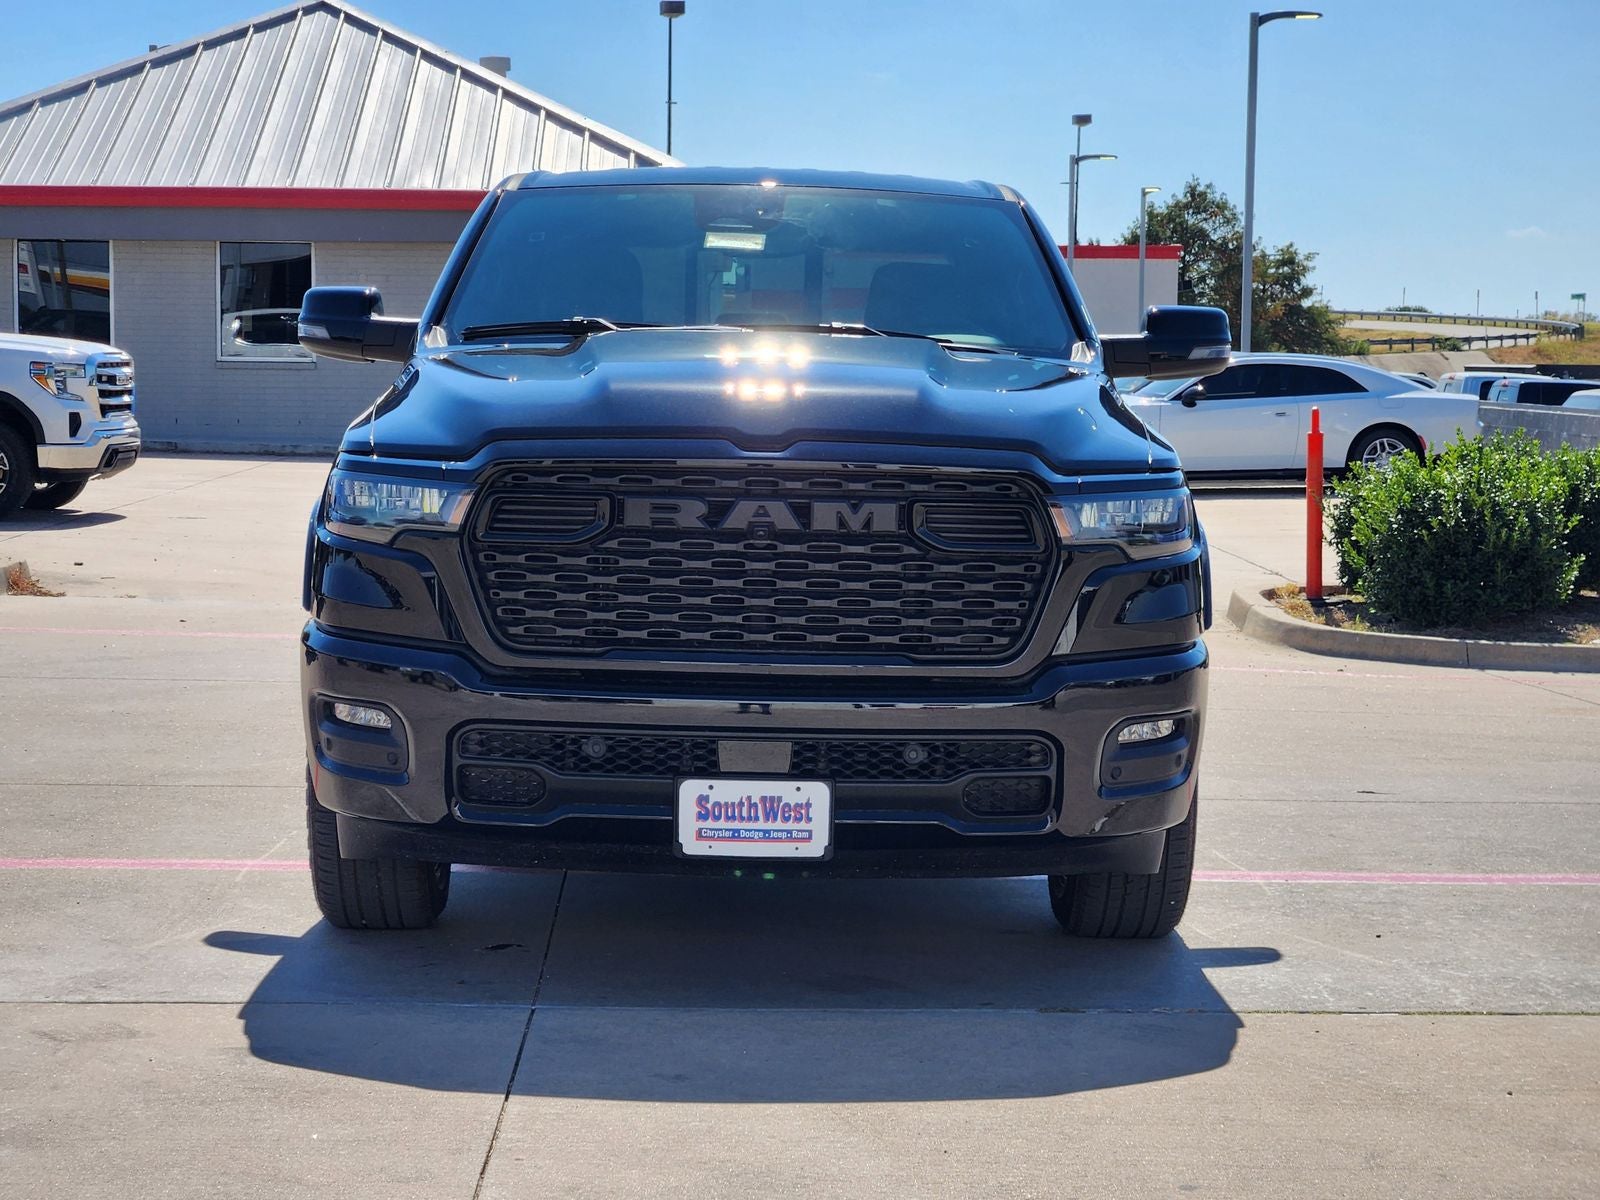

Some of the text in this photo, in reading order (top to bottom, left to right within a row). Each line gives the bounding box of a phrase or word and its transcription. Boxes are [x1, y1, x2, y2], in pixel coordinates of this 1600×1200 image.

[624, 497, 898, 533] RAM
[695, 794, 813, 823] SouthWest
[701, 829, 809, 839] Chrysler Dodge Jeep Ram
